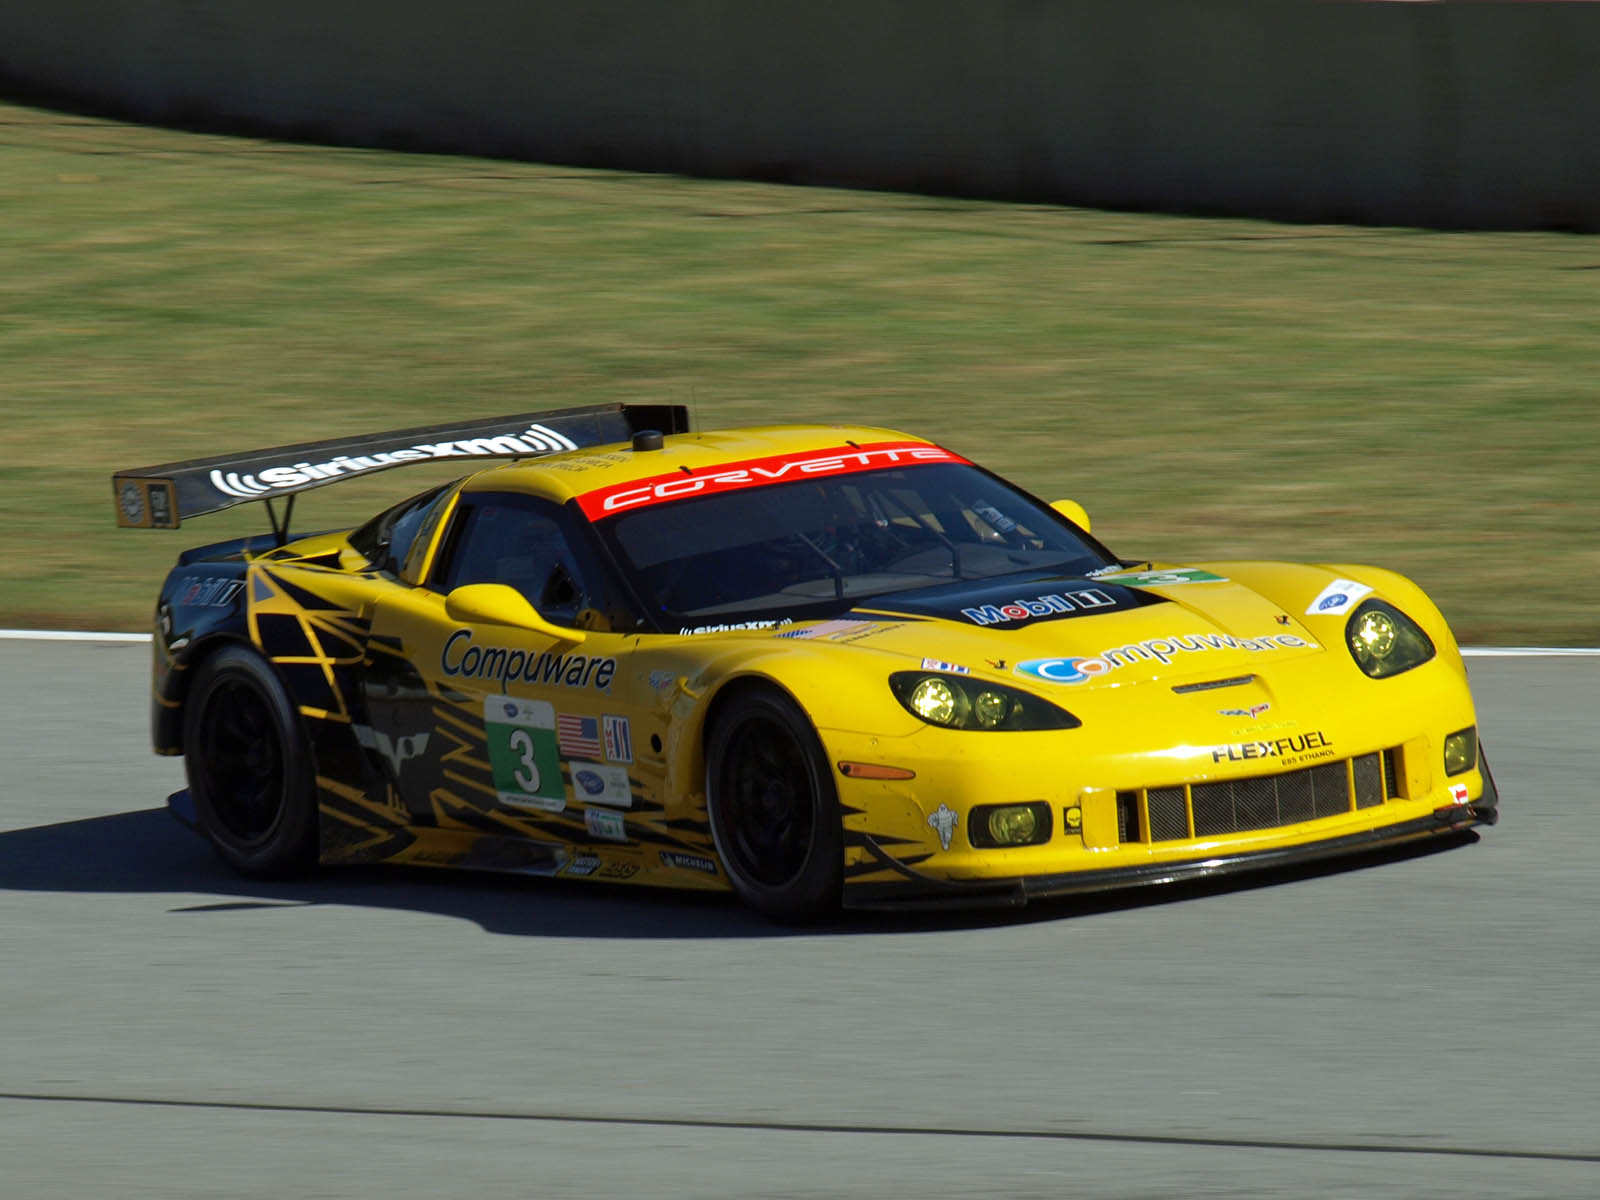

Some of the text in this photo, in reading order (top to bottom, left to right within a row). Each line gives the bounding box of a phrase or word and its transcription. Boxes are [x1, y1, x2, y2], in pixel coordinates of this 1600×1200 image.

[603, 447, 951, 511] CORVETTE
[961, 594, 1076, 626] Mobil
[441, 629, 616, 695] Compuware
[1037, 633, 1305, 681] Compuware
[510, 729, 541, 793] 3
[1212, 731, 1333, 763] FLEXFUEL
[1299, 749, 1335, 763] ETHANOL
